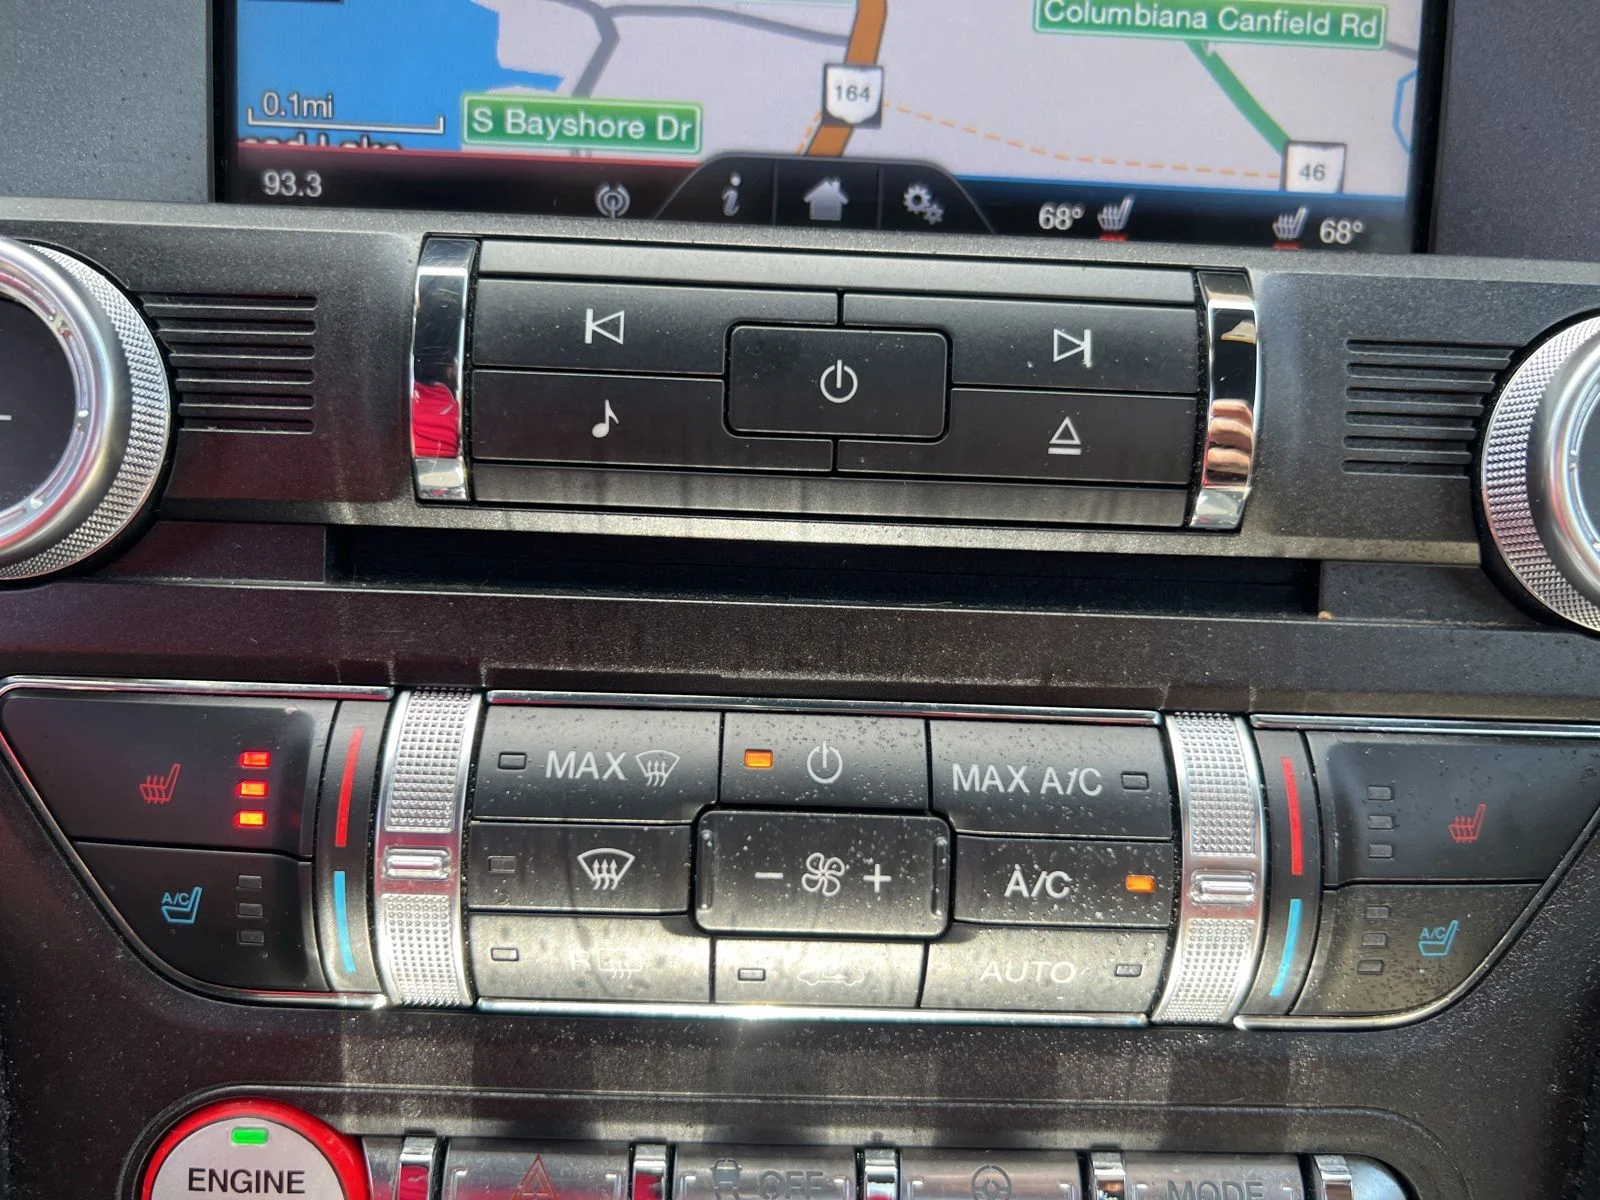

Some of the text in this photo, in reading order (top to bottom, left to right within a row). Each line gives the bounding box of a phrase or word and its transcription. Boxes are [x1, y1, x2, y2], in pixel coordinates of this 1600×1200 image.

[1043, 0, 1377, 38] Columbiana Canfield Rd
[834, 83, 871, 103] 164
[471, 110, 692, 145] S Bayshore Dr
[262, 170, 323, 197] 93.3
[1299, 163, 1326, 182] 46
[545, 751, 626, 780] MAX
[952, 763, 1103, 797] MAX A/C
[1004, 866, 1072, 898] A/C
[161, 892, 189, 905] A/C
[1419, 926, 1446, 940] A/C
[979, 961, 1077, 985] AUTO
[188, 1167, 306, 1195] ENGINE
[759, 1171, 824, 1200] OFF
[1167, 1180, 1263, 1200] MODE
